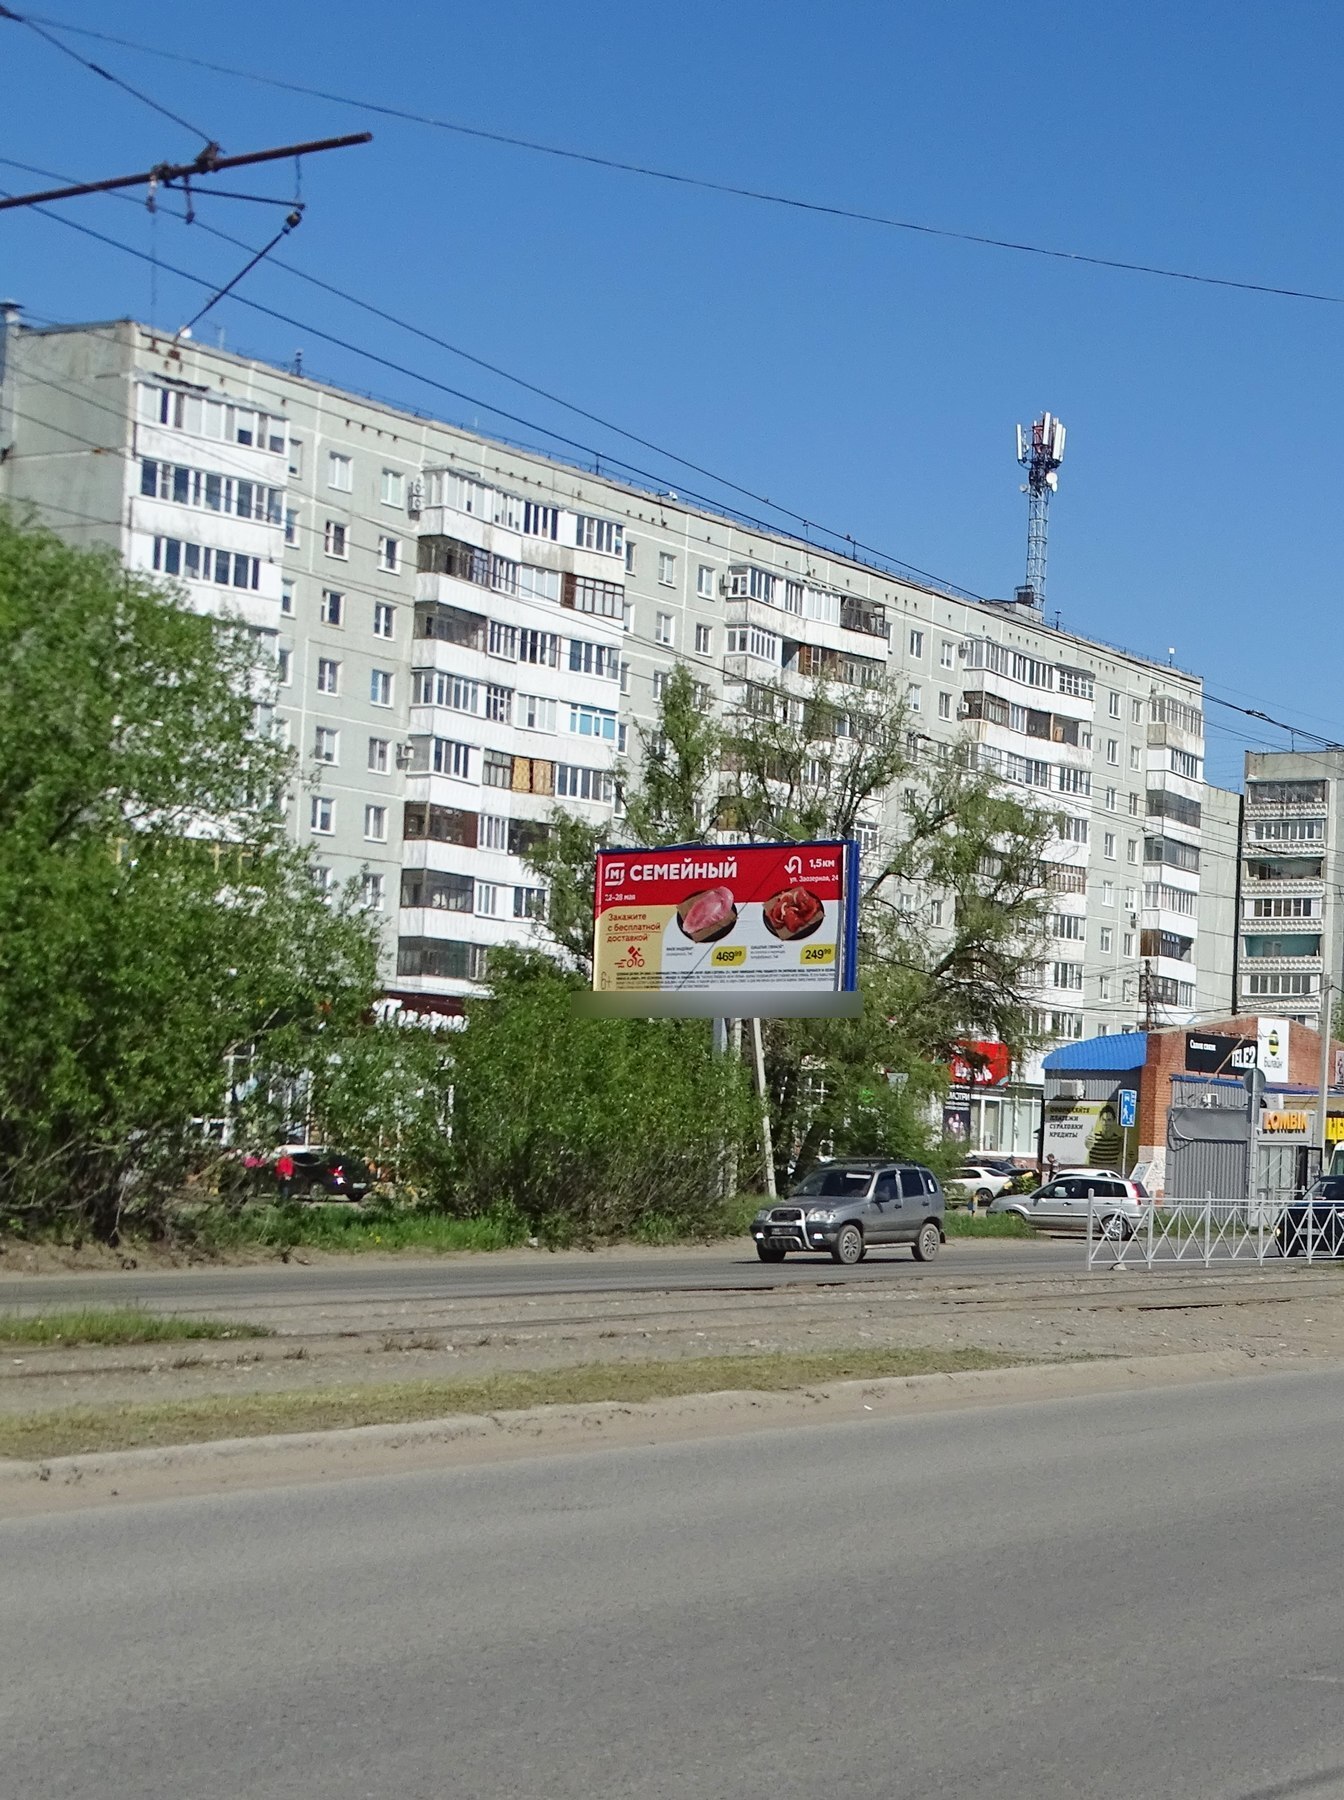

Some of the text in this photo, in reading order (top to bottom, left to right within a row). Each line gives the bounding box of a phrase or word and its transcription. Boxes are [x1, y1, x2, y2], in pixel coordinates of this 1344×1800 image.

[629, 856, 737, 881] СЕМЕЙНЫЙ
[608, 913, 647, 921] Закажите
[614, 922, 661, 932] бесплатной
[607, 933, 648, 943] доставкой
[1231, 1046, 1256, 1069] TELE2
